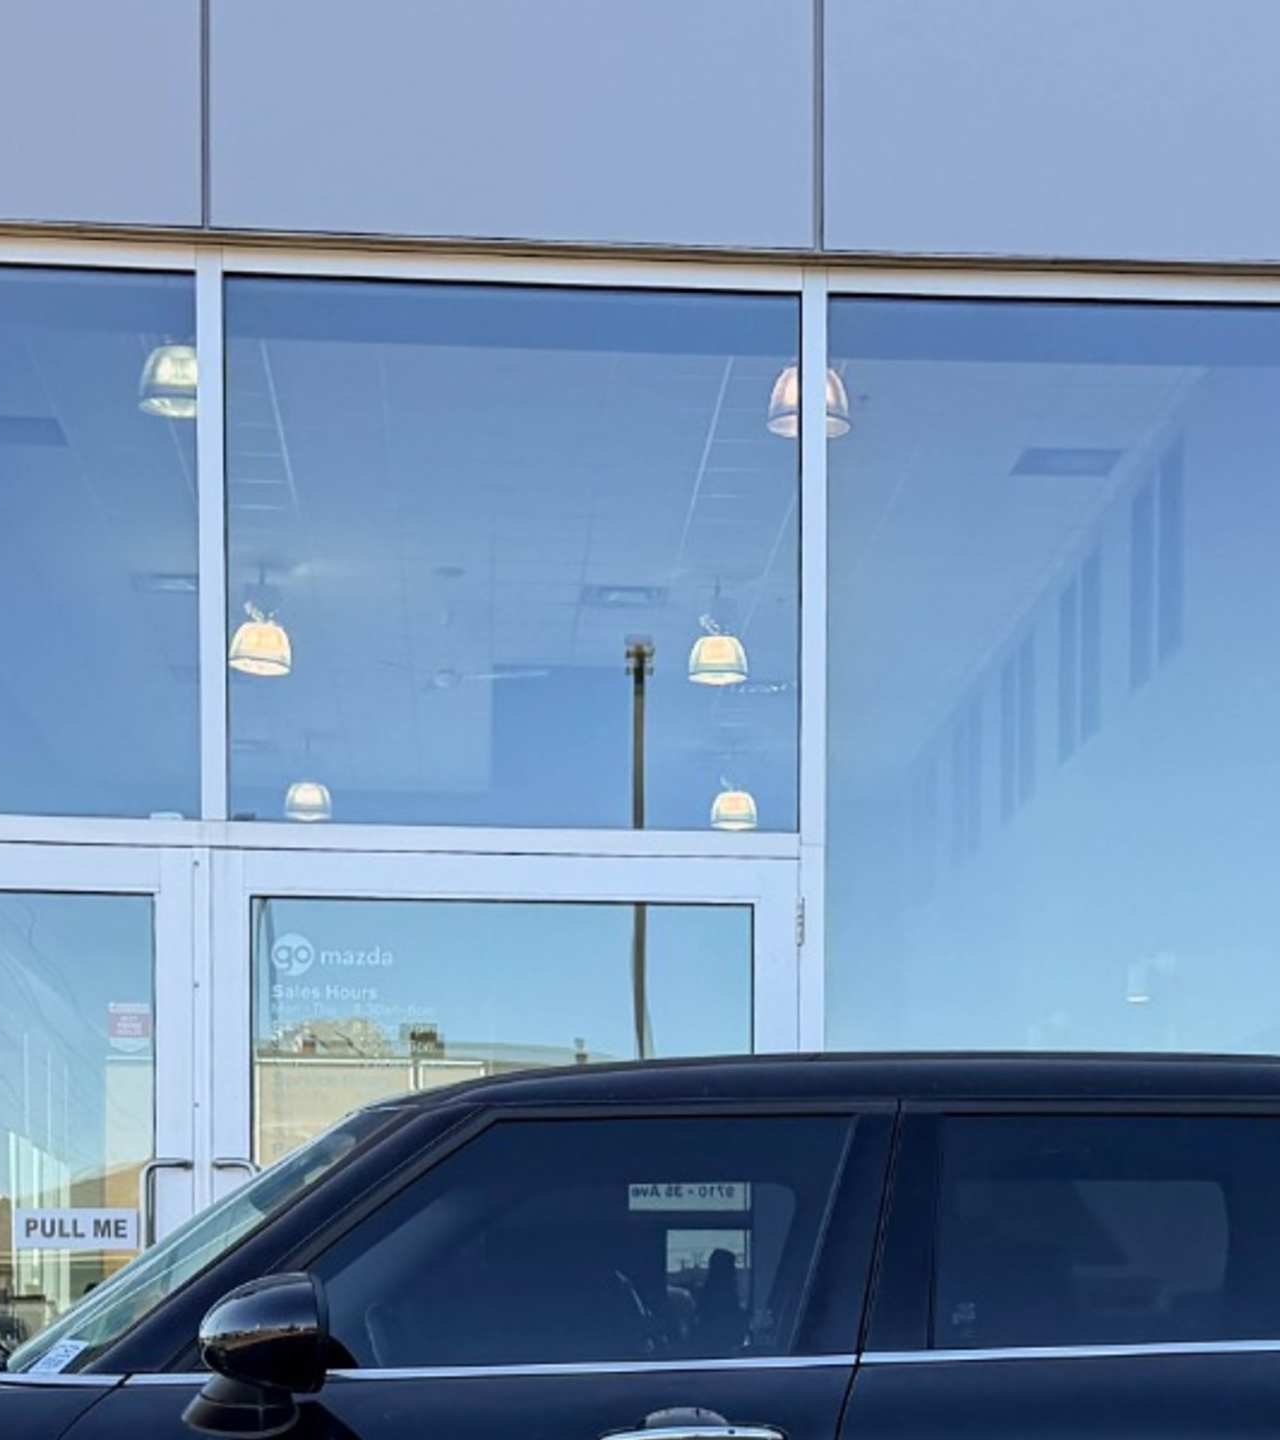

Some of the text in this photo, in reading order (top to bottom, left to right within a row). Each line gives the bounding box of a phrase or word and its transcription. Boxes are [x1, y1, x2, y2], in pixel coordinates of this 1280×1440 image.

[321, 946, 393, 966] mazda
[272, 984, 378, 1000] Sales Hours
[24, 1218, 128, 1239] PULL ME
